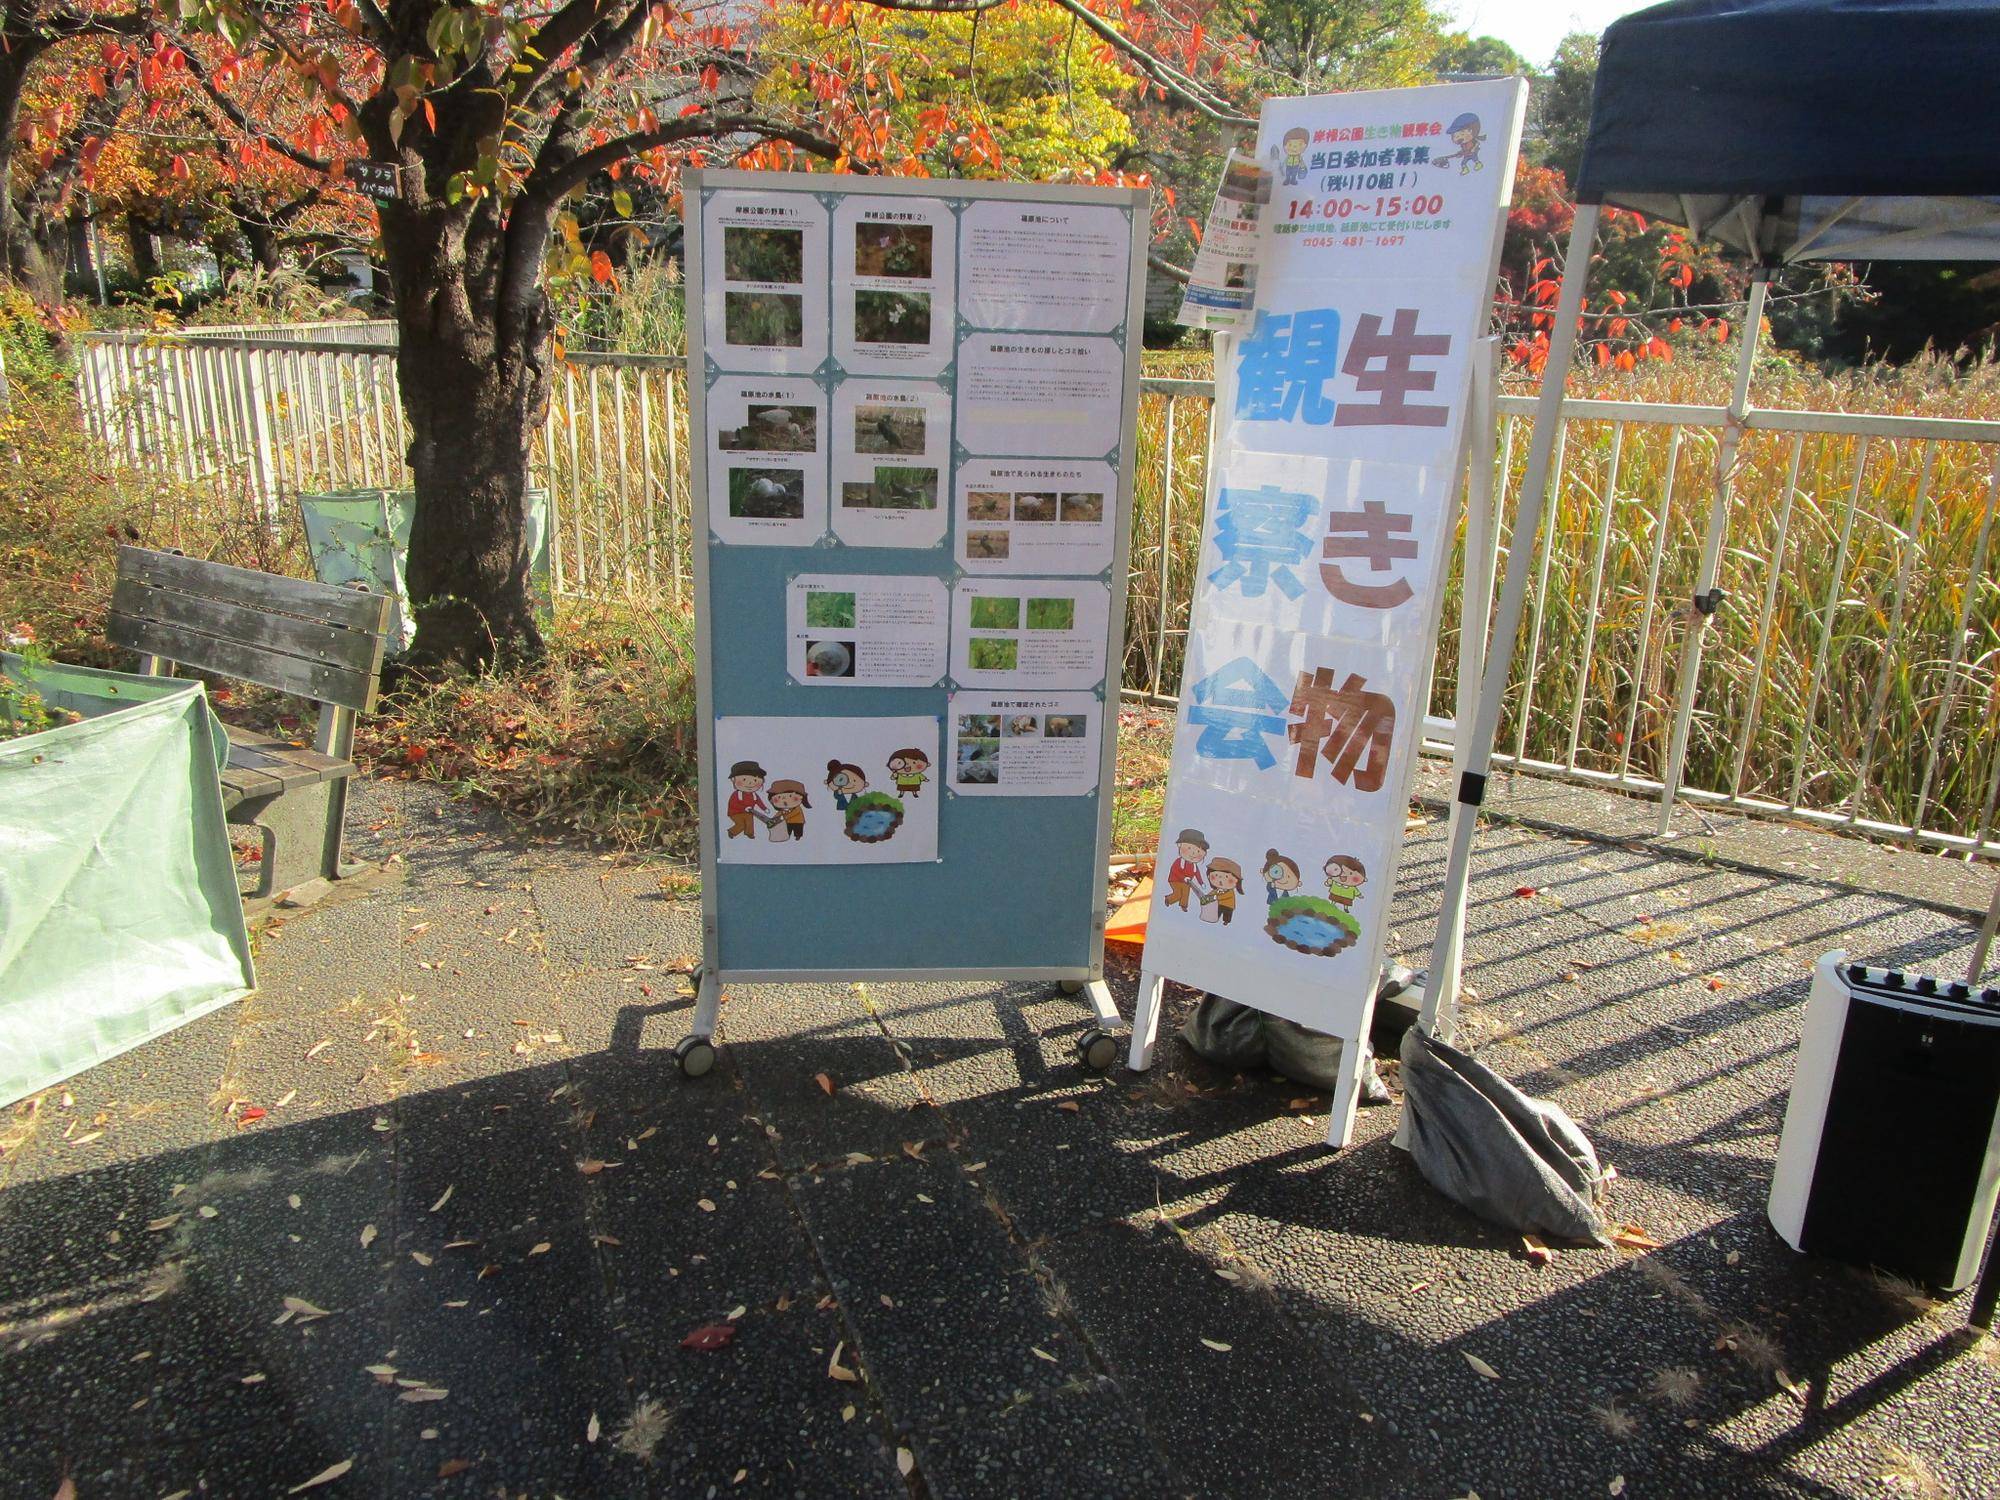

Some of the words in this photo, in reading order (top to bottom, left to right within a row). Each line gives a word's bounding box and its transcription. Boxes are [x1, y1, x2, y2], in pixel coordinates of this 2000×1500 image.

[1313, 122, 1442, 143] 岸根公園生き物観察会
[1310, 145, 1431, 170] 当日参加者募集
[1288, 194, 1444, 219] 14:00～15:00
[1021, 215, 1070, 224] 篠原池について
[1187, 308, 1342, 769] 観察会
[1287, 308, 1451, 793] 生き物
